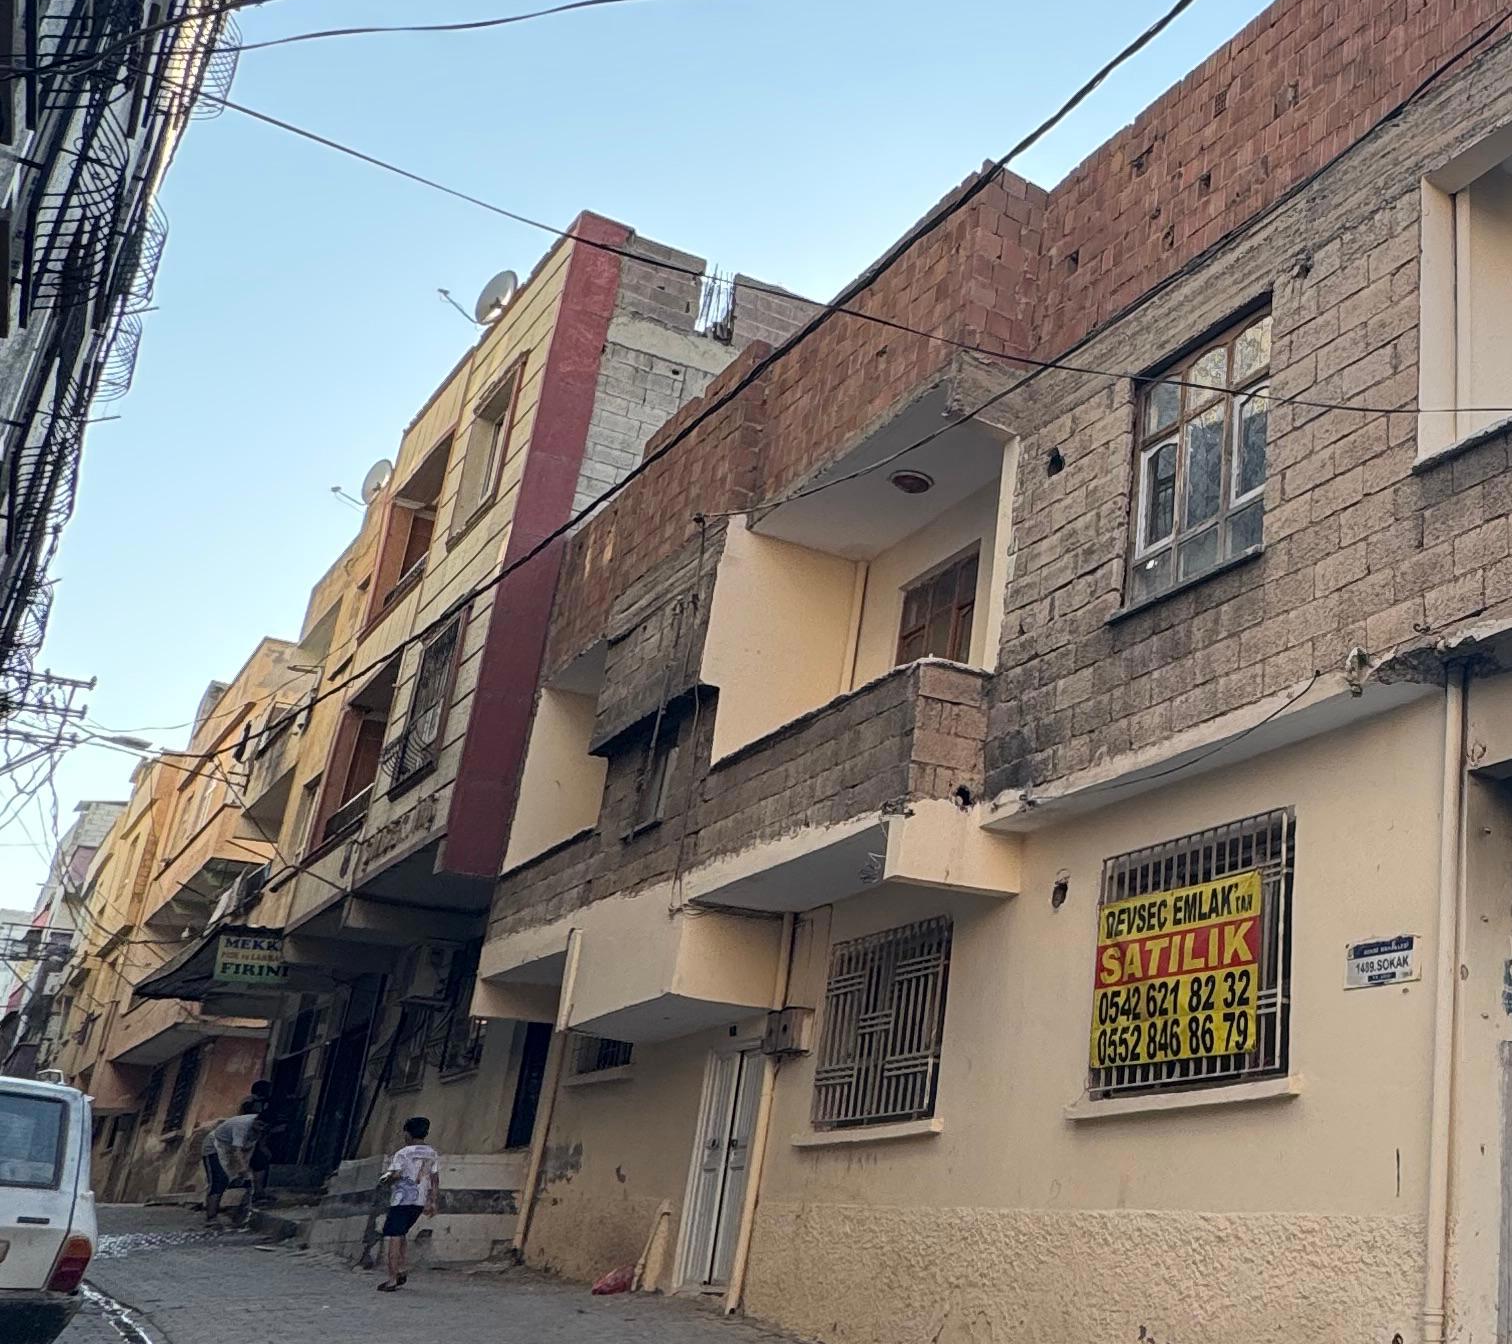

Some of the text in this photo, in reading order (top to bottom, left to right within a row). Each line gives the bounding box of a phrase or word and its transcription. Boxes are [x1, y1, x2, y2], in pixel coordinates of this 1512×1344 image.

[1106, 899, 1168, 939] DEVSEÇ
[224, 937, 280, 951] MEKK
[1100, 920, 1254, 985] SATILIK
[221, 962, 289, 977] FIRINI
[1098, 969, 1251, 1026] 0542 621 82 32
[1097, 1010, 1249, 1066] 0552 846 86 79
